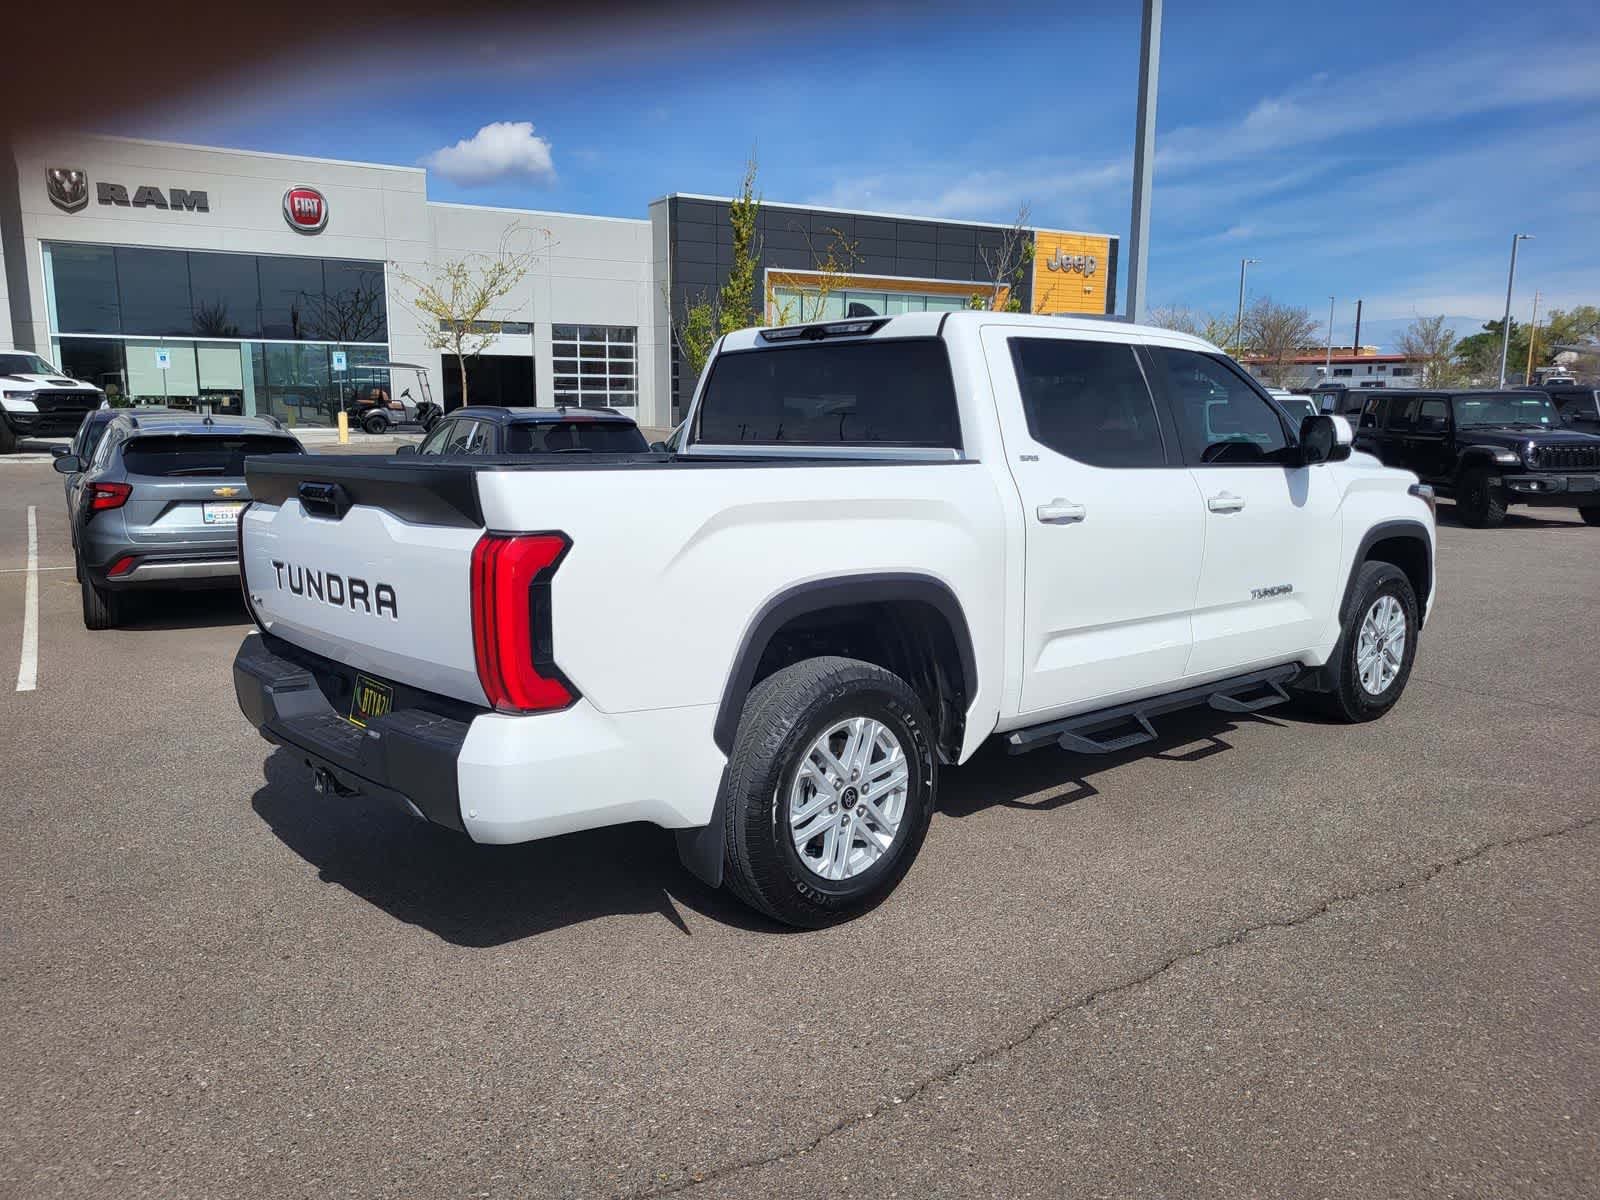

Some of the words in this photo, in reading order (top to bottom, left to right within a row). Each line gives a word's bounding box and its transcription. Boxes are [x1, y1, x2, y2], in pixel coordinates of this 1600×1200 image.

[96, 182, 209, 213] RAM
[293, 197, 319, 217] FIAT
[1047, 247, 1097, 278] Jeep
[271, 559, 399, 620] TUNDRA
[1250, 583, 1293, 601] TUNDRA
